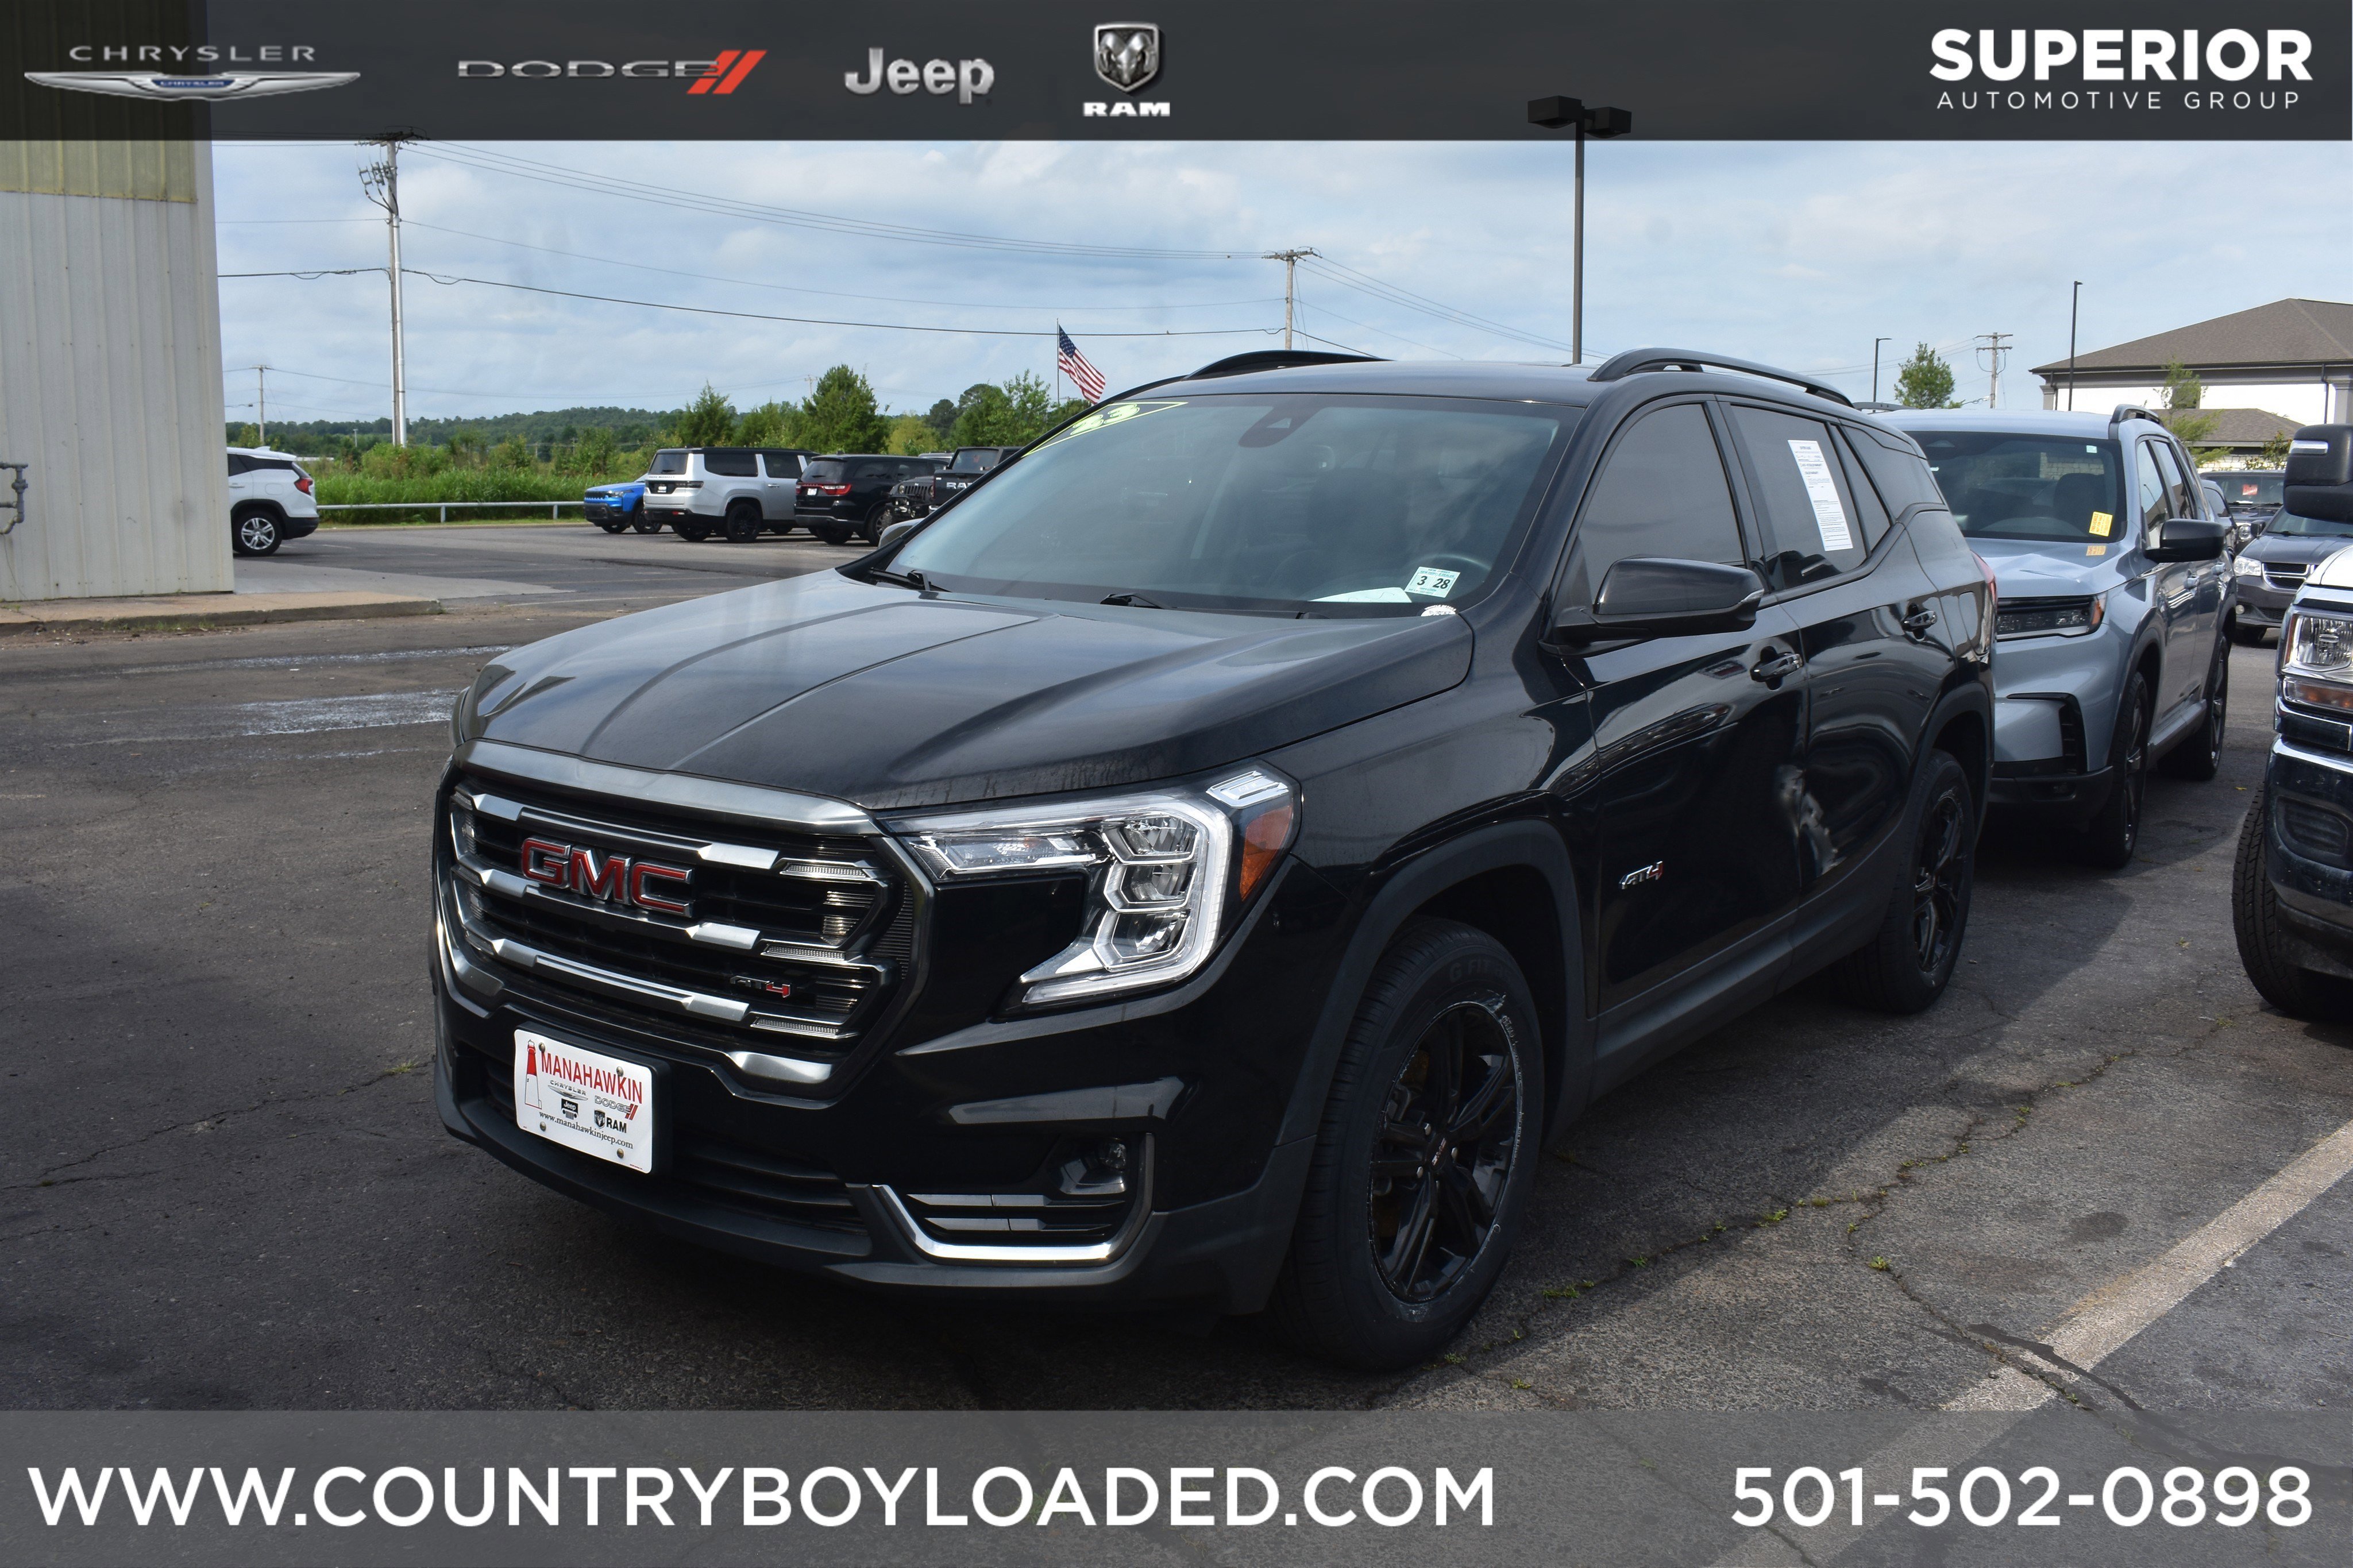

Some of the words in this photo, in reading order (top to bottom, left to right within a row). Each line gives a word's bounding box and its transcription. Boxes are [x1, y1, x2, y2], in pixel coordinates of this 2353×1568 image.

[1417, 576, 1428, 586] 3
[1432, 578, 1451, 589] 28
[521, 835, 696, 918] GMC
[1619, 860, 1663, 890] AT4
[730, 975, 792, 998] AT4
[541, 1050, 643, 1104] MANAHAWKIN
[550, 1080, 587, 1096] CHRYSLER
[563, 1100, 577, 1112] Jeep
[595, 1095, 632, 1114] DODGE
[539, 1111, 634, 1149] www.manahawkinjeep.com
[606, 1117, 627, 1134] RAM
